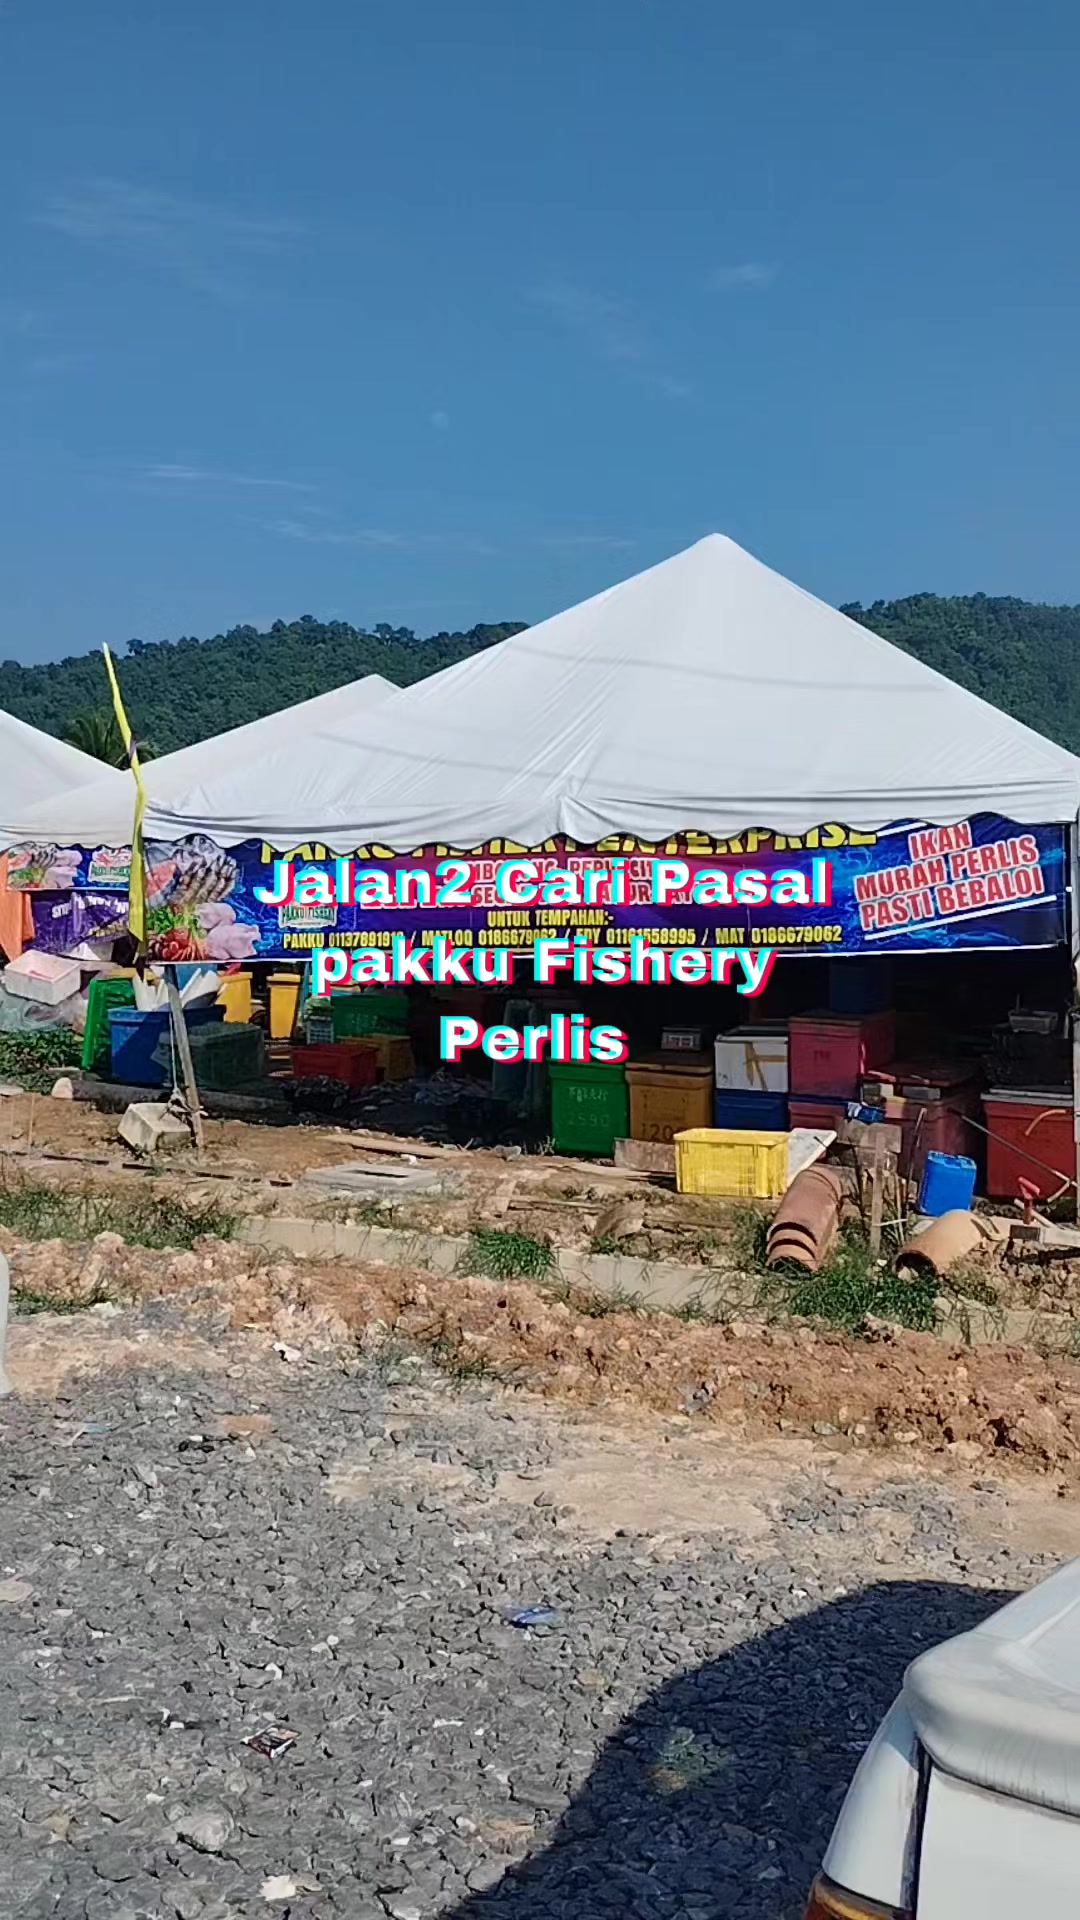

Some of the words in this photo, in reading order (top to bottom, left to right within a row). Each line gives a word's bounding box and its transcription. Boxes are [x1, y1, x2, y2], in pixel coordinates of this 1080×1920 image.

[909, 823, 971, 859] IKAN
[855, 859, 945, 900] MURAH
[951, 836, 1037, 879] PERLIS
[861, 889, 933, 929] PASTI
[936, 867, 1044, 914] BEBALOI
[487, 910, 530, 927] UNTUK
[283, 932, 324, 949] PAKKU
[328, 931, 404, 947] 011378919
[715, 928, 745, 945] MAT
[751, 926, 842, 944] 0186679062
